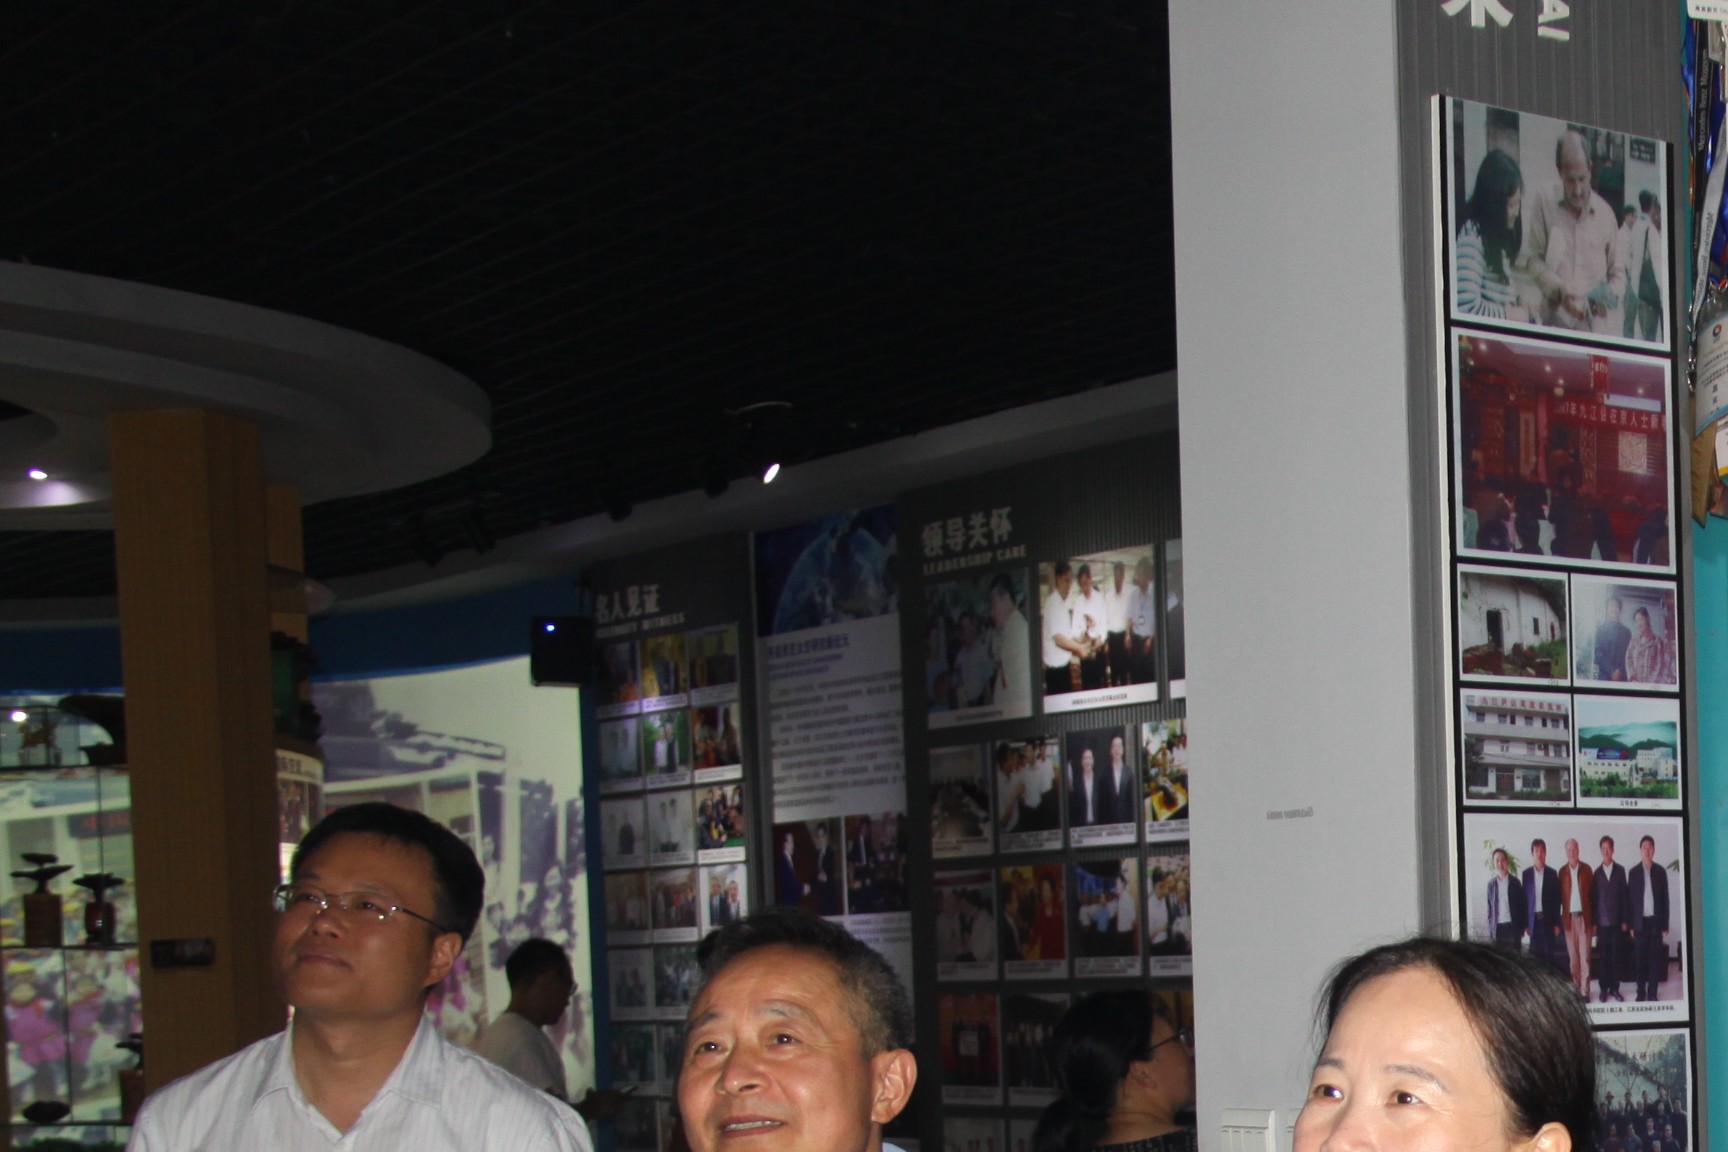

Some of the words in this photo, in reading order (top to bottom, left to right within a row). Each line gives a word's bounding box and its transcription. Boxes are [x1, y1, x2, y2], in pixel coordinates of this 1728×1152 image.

[921, 506, 1013, 558] 领导关怀
[996, 543, 1027, 562] CARE
